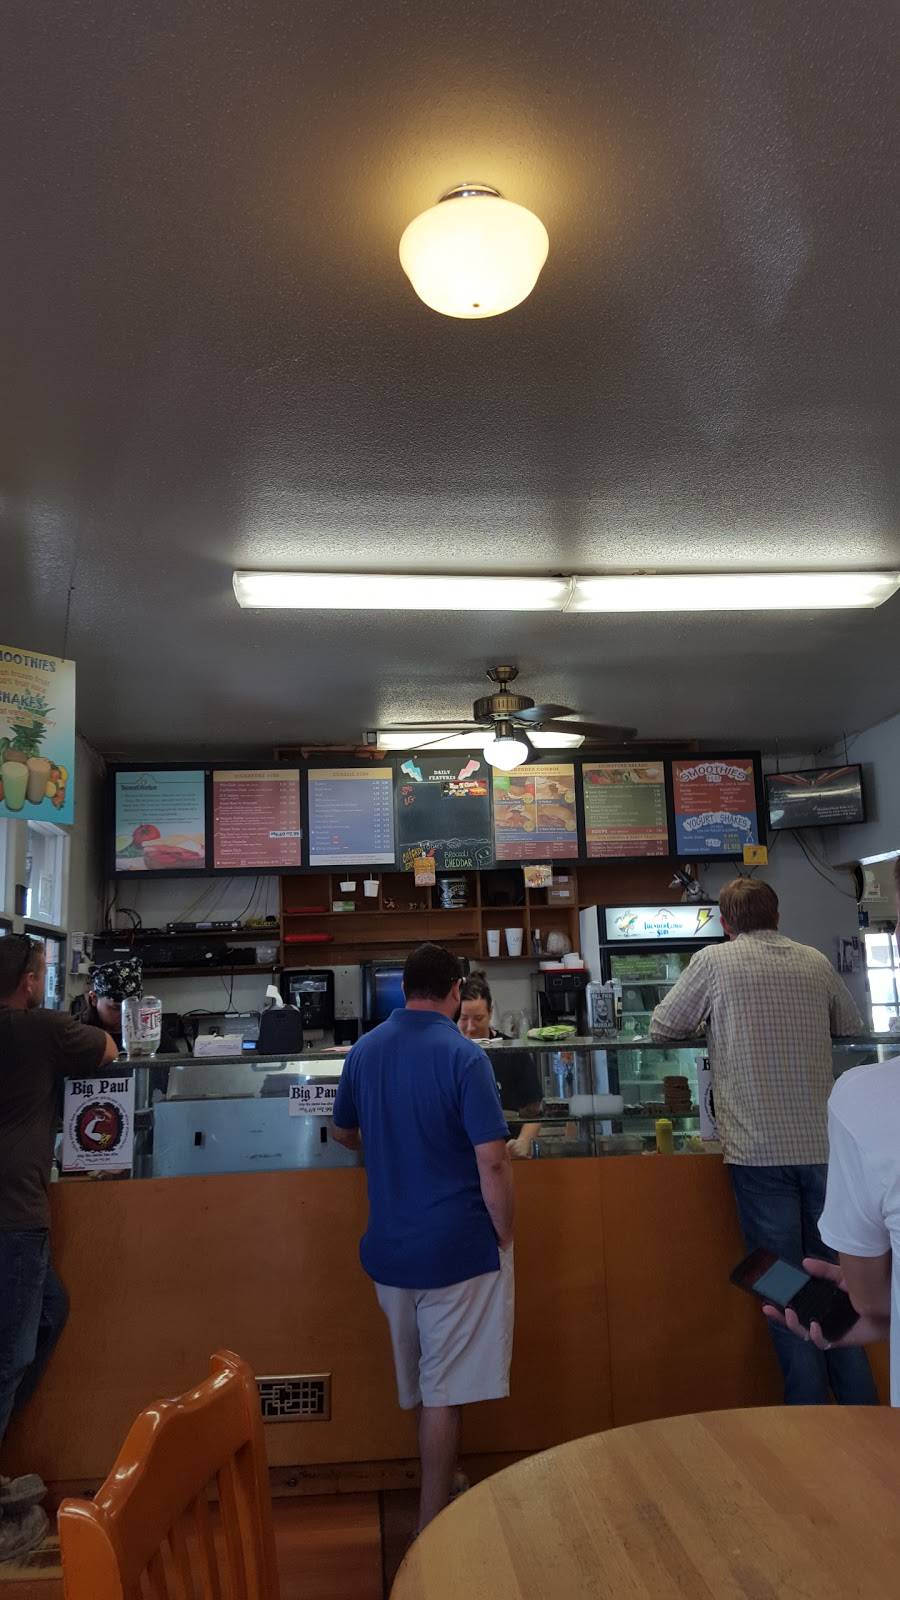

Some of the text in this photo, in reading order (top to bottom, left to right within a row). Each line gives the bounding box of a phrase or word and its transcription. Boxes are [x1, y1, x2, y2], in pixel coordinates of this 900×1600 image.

[680, 765, 746, 780] SMOOTHIES
[686, 814, 714, 828] YOGURT
[444, 858, 473, 868] CHEDDAR
[70, 1078, 129, 1098] Big Paul
[290, 1086, 337, 1102] Big Pau
